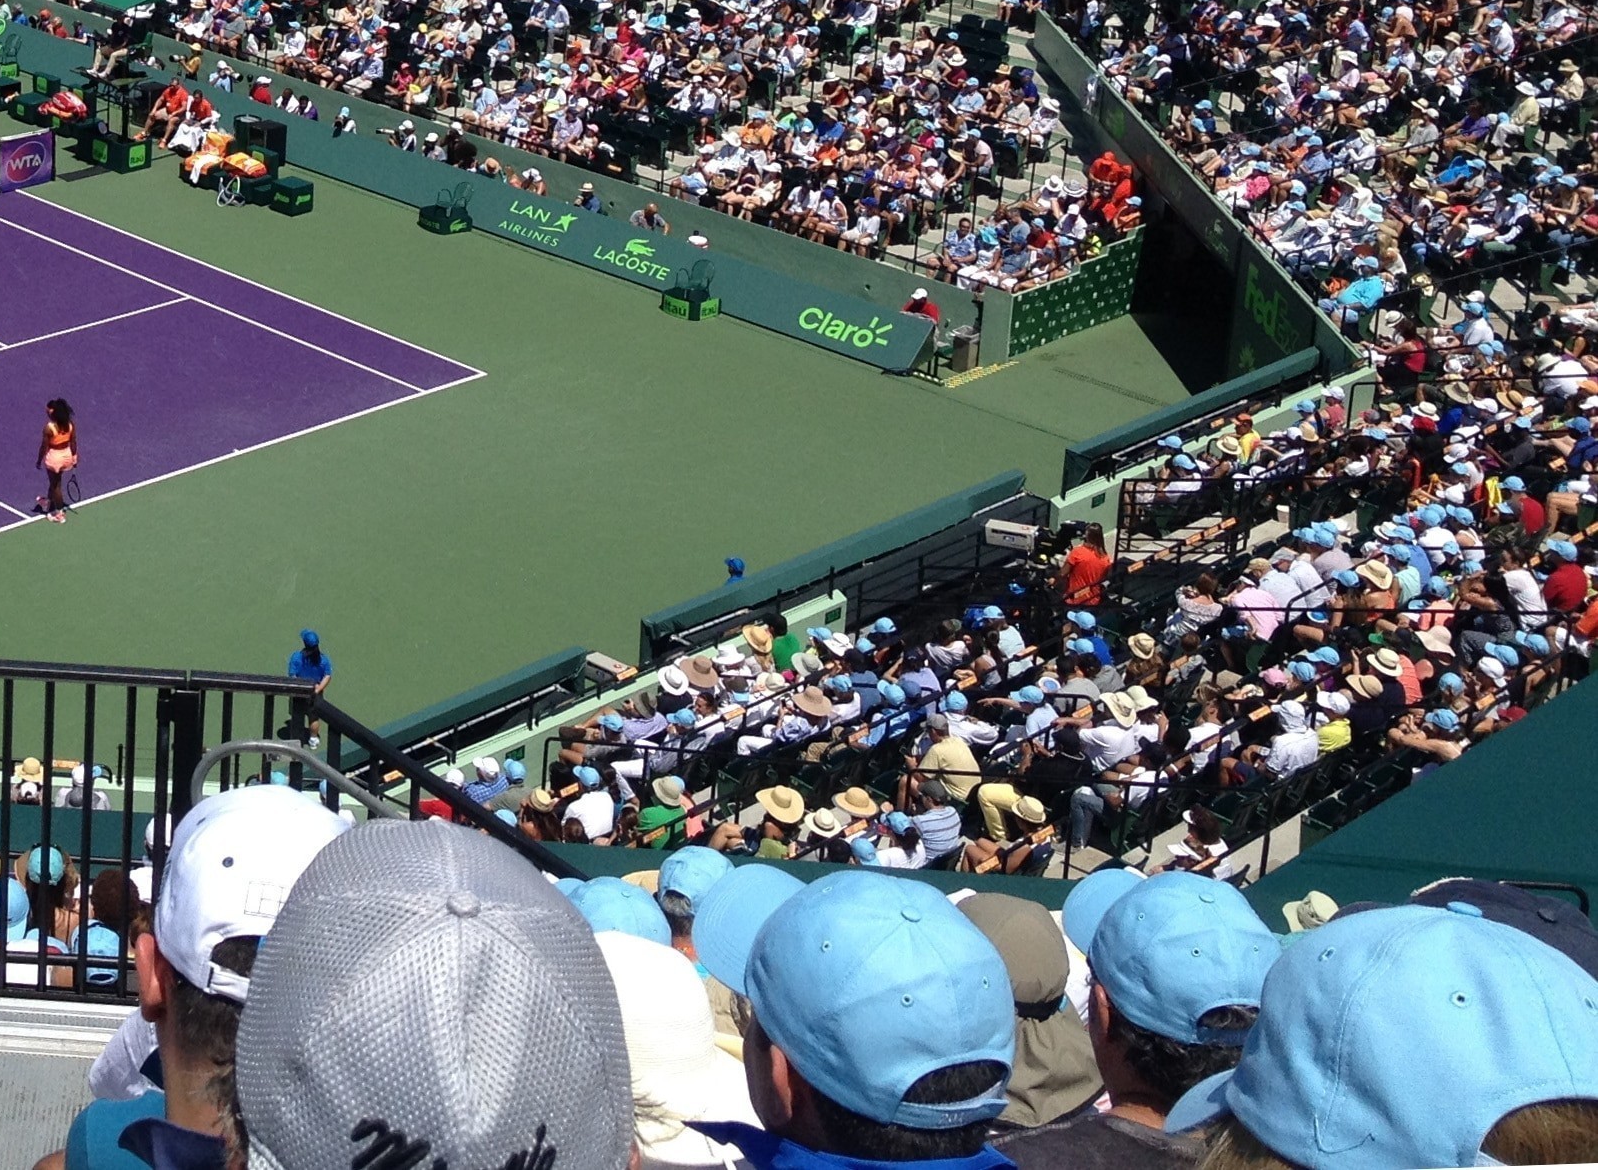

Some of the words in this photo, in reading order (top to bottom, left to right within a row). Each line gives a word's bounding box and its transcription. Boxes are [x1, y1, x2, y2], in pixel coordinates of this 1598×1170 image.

[9, 154, 43, 171] WTA
[509, 201, 551, 223] LAN
[498, 220, 560, 248] AIRLINES
[592, 245, 671, 281] LACOSTE
[798, 307, 874, 348] Claro
